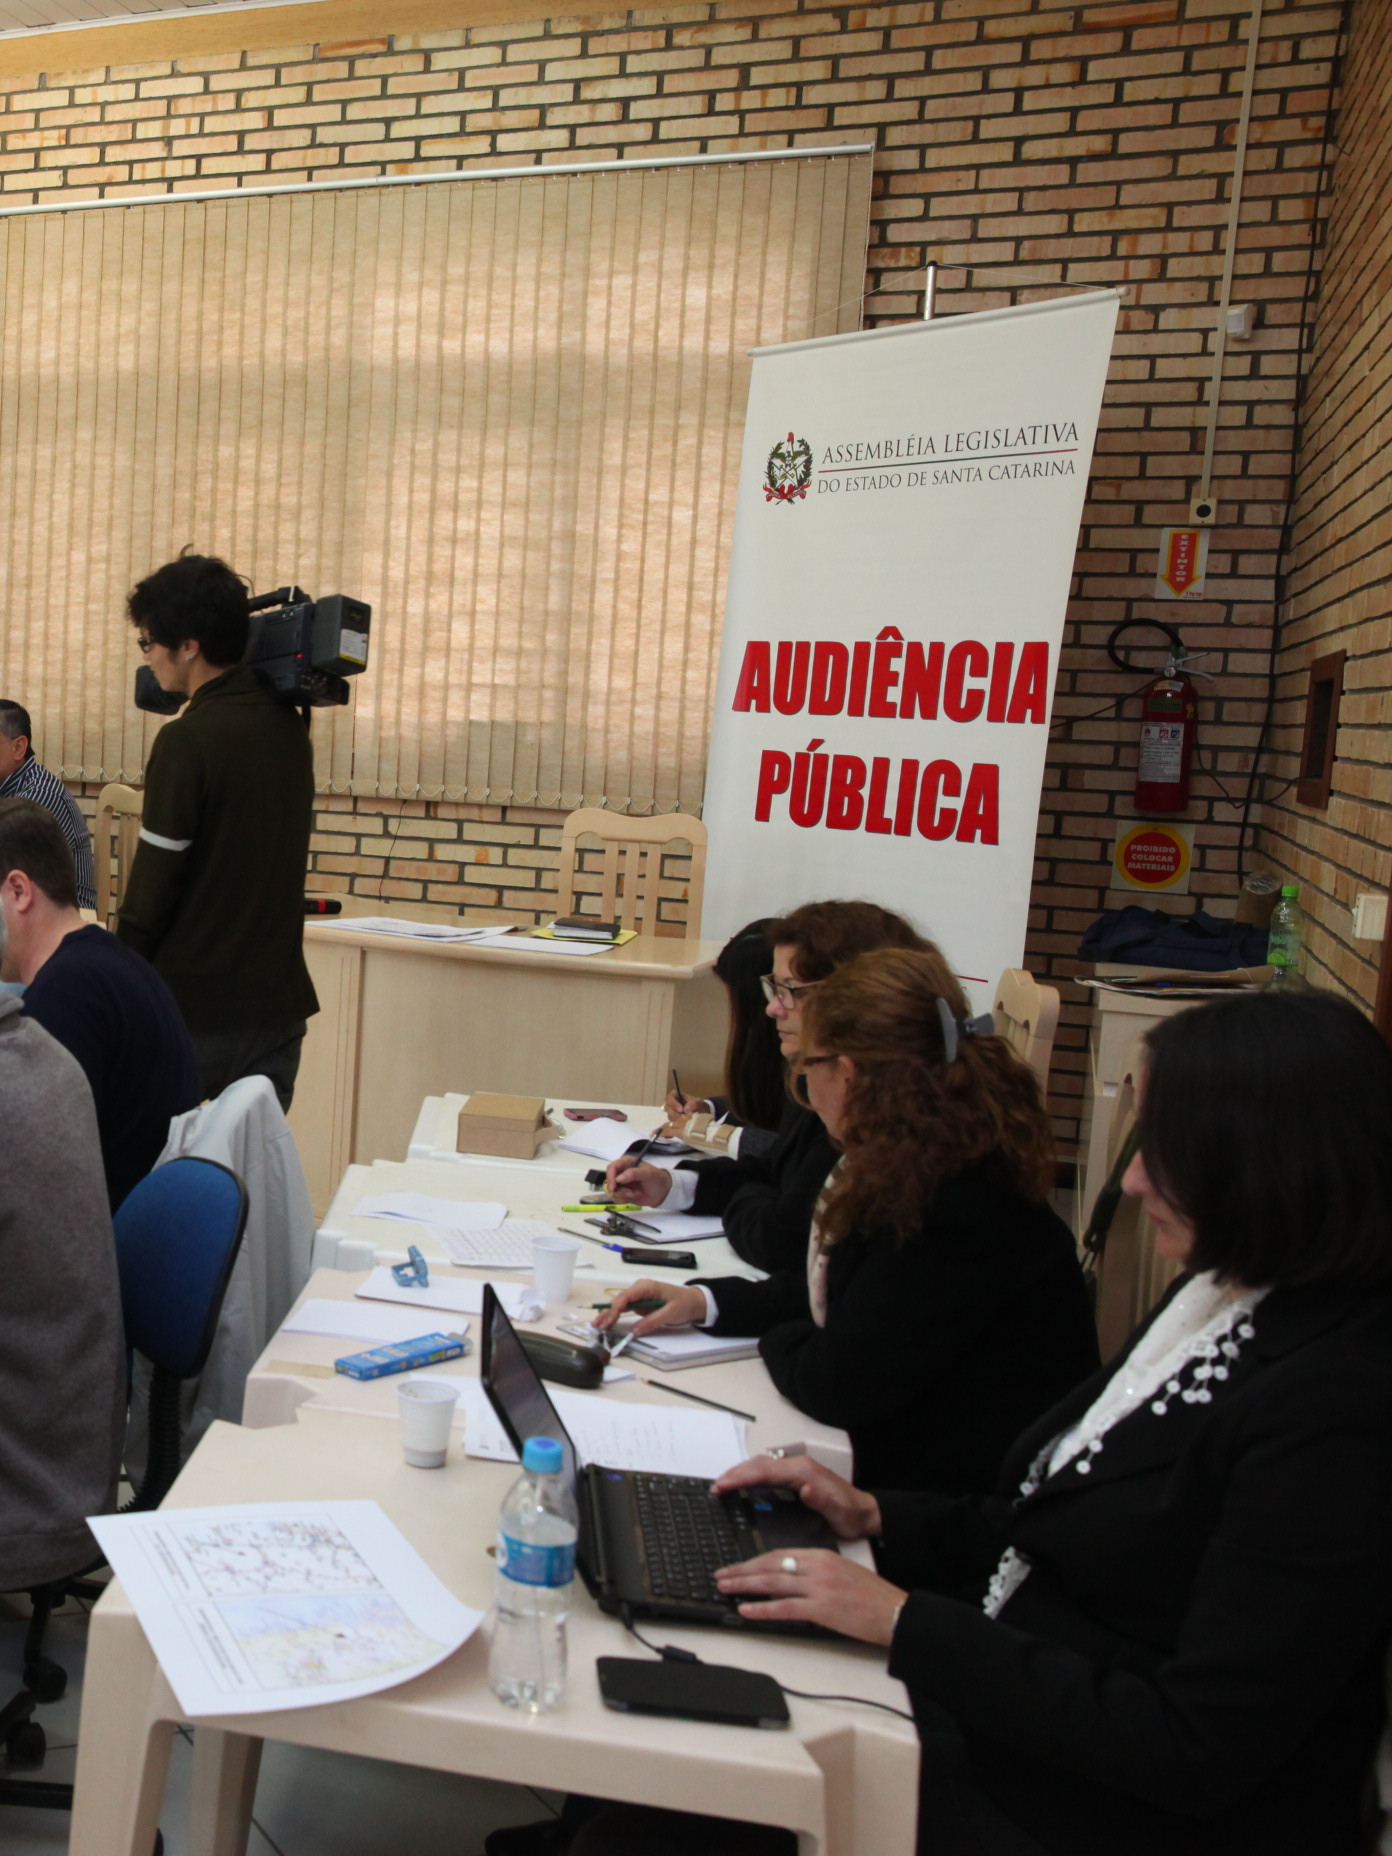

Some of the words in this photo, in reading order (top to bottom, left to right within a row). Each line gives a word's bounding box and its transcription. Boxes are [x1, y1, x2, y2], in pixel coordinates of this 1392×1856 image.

[821, 433, 936, 465] ASSEMBLÉIA
[943, 421, 1079, 453] LEGISLATIVA
[817, 478, 841, 494] DO
[845, 473, 902, 492] ESTADO
[907, 471, 927, 487] DE
[931, 466, 983, 485] SANTA
[988, 459, 1075, 481] CATARINA
[1175, 534, 1190, 582] EXTINTOR
[731, 626, 1049, 724] AUDIÊNCIA
[754, 738, 999, 846] PÚBLICA
[1127, 862, 1176, 872] MATERIAIS
[1130, 844, 1176, 854] PROIBIDO
[1131, 853, 1174, 863] COLOCAR
